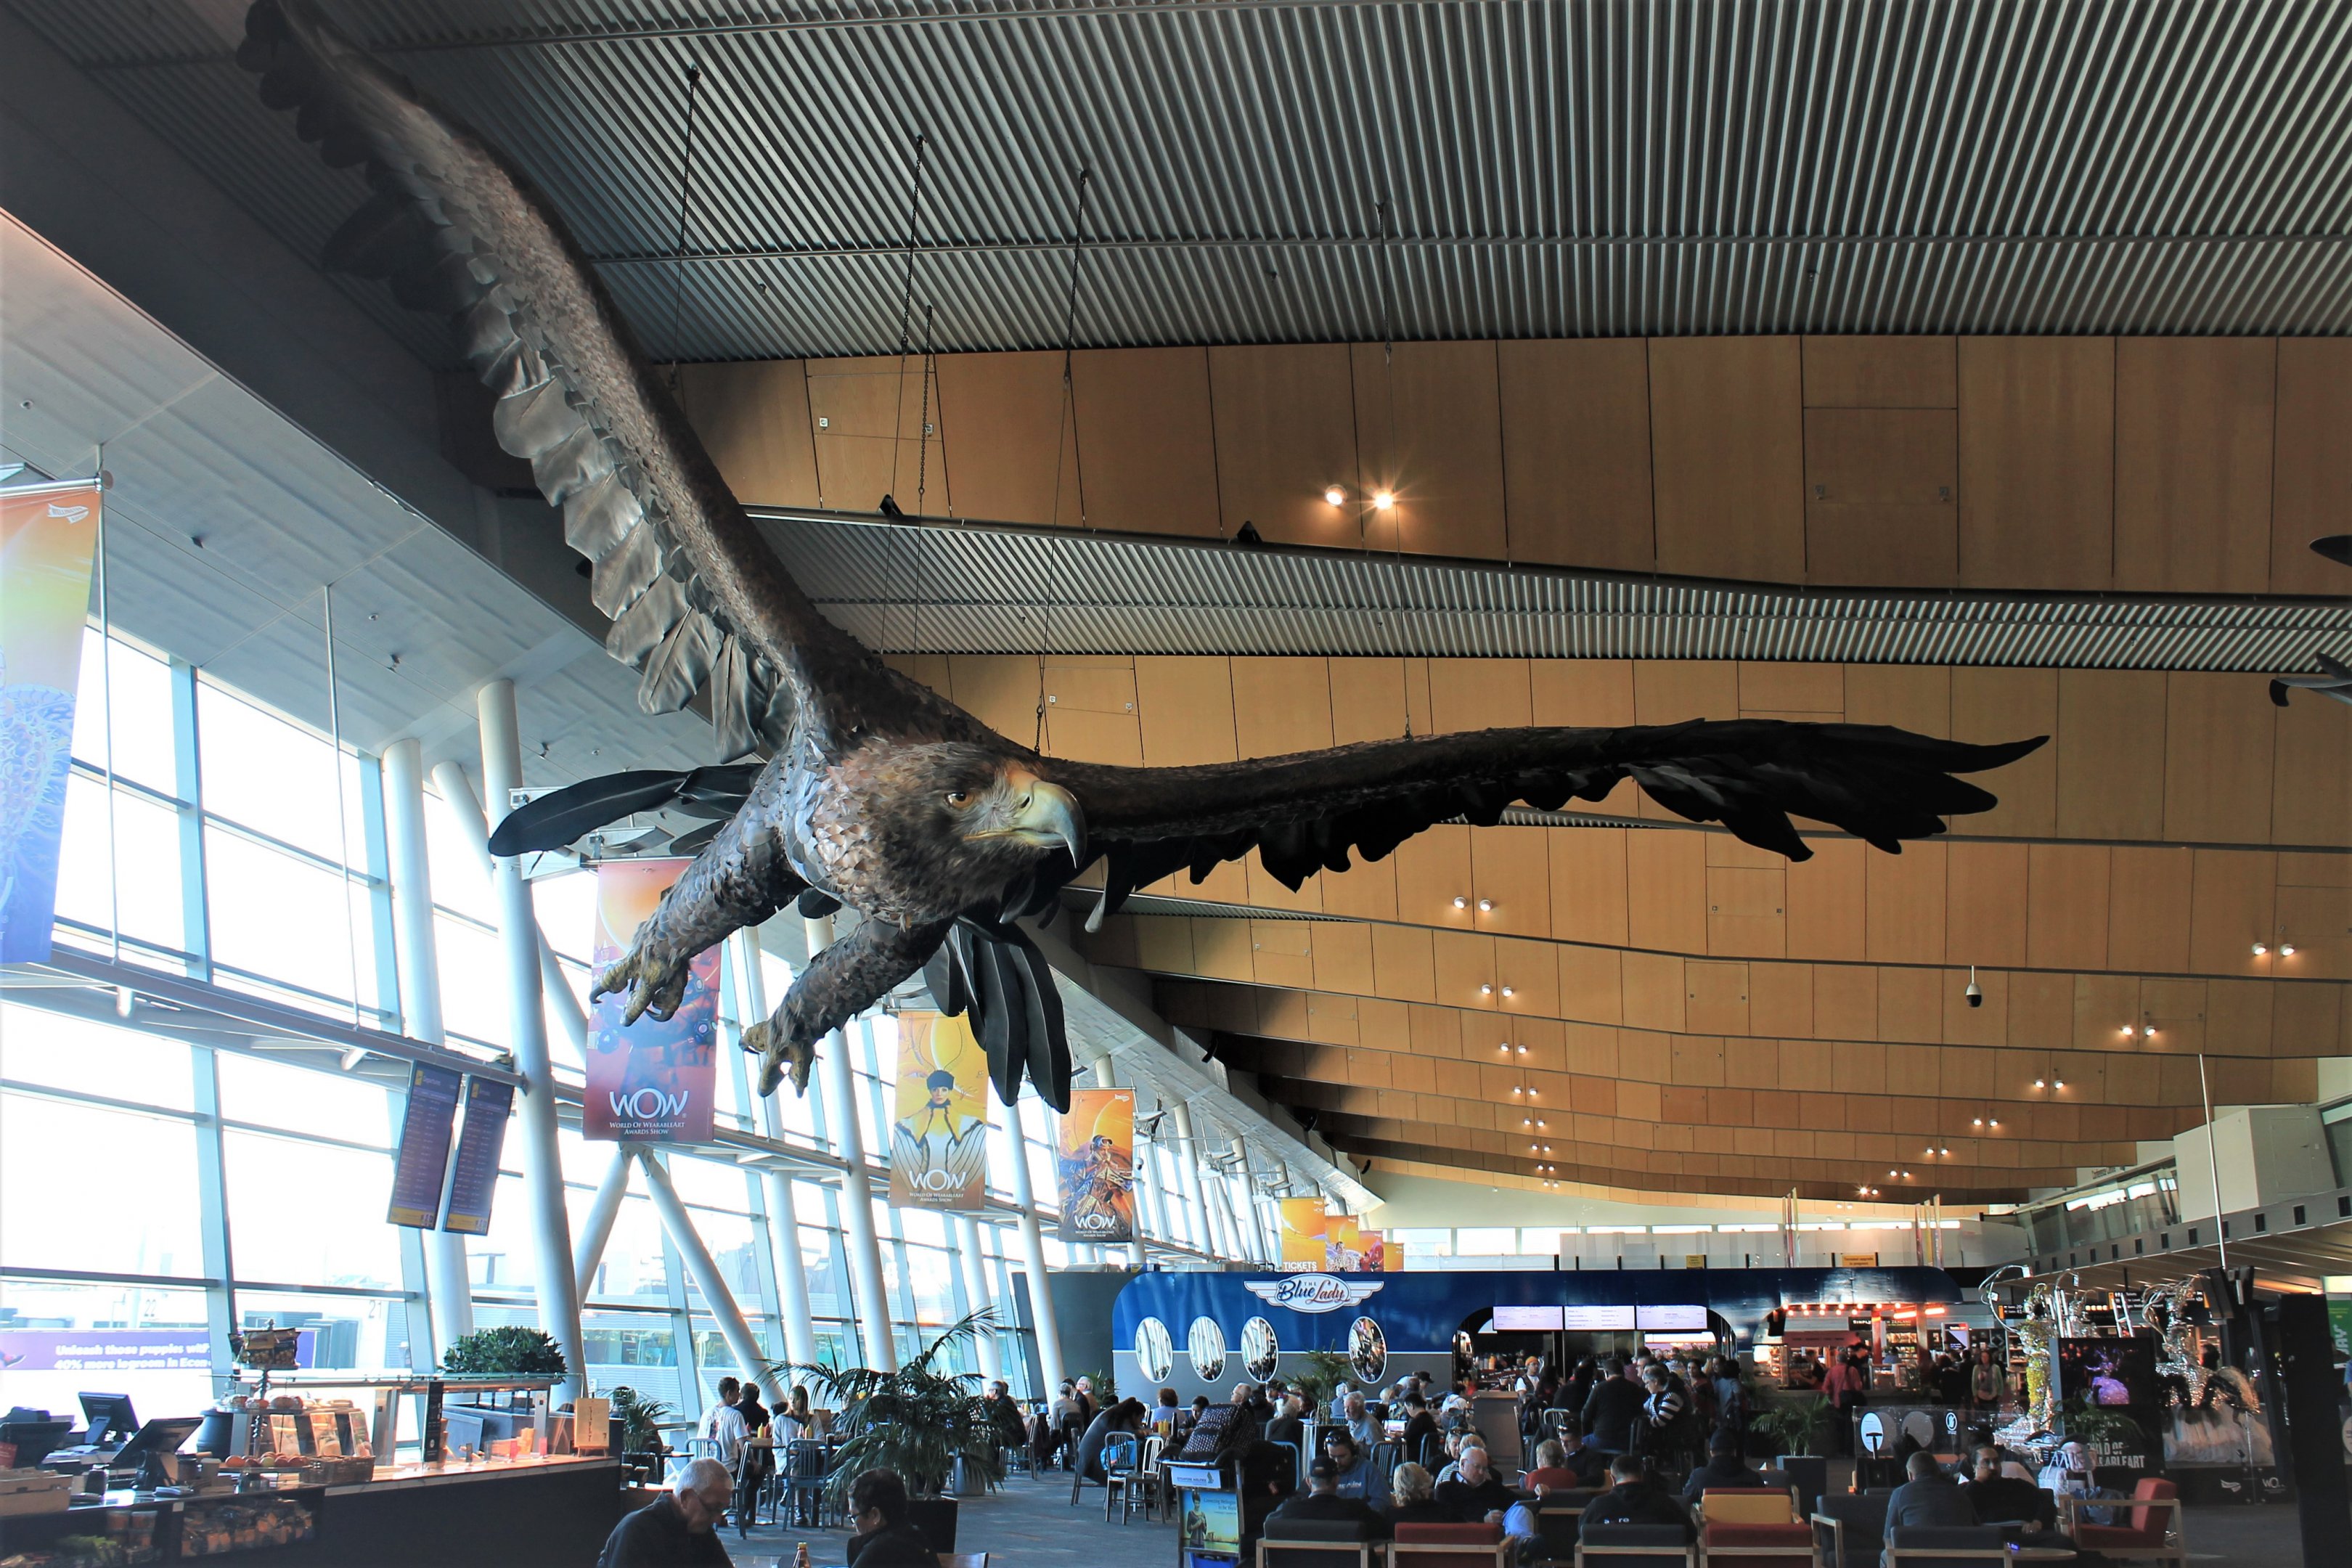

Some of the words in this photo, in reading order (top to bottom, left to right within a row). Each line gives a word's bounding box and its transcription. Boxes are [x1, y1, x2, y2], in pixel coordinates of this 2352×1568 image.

[609, 1087, 689, 1119] WOW
[909, 1169, 967, 1191] WOW
[1074, 1214, 1116, 1229] WOW
[1283, 1261, 1318, 1270] TICKETS
[1277, 1280, 1316, 1301] Blue
[1305, 1280, 1351, 1305] Lady
[144, 1299, 157, 1318] 22
[369, 1299, 382, 1319] 21
[55, 1344, 103, 1355] Unleash
[105, 1344, 138, 1355] those
[139, 1343, 184, 1356] puppies
[54, 1359, 83, 1370] 40%
[83, 1360, 116, 1370] more
[117, 1358, 166, 1371] legroom
[166, 1357, 179, 1368] in
